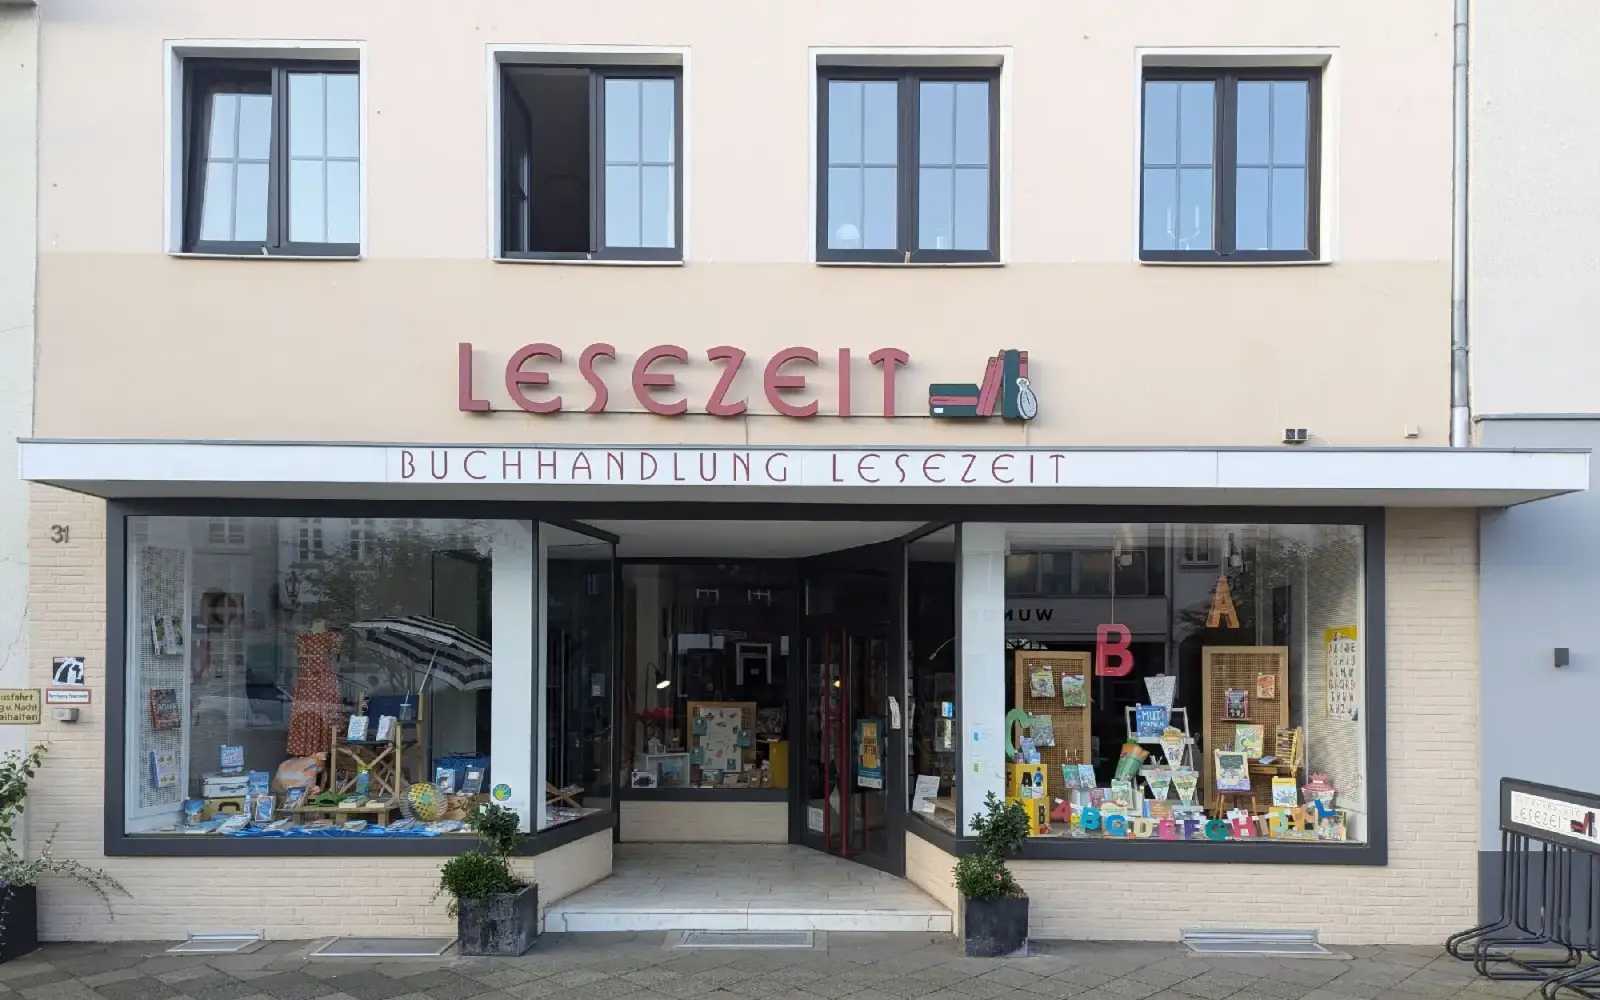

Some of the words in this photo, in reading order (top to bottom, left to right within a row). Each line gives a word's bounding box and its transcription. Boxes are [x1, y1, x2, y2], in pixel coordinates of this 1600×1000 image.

[458, 342, 910, 418] LESEZEIT
[401, 450, 788, 482] BUCHHANDLUNG
[832, 453, 1066, 483] LESEZEIT
[50, 524, 70, 543] 31
[1095, 623, 1134, 676] B
[1, 692, 33, 701] usfahrt
[14, 703, 38, 711] Nacht
